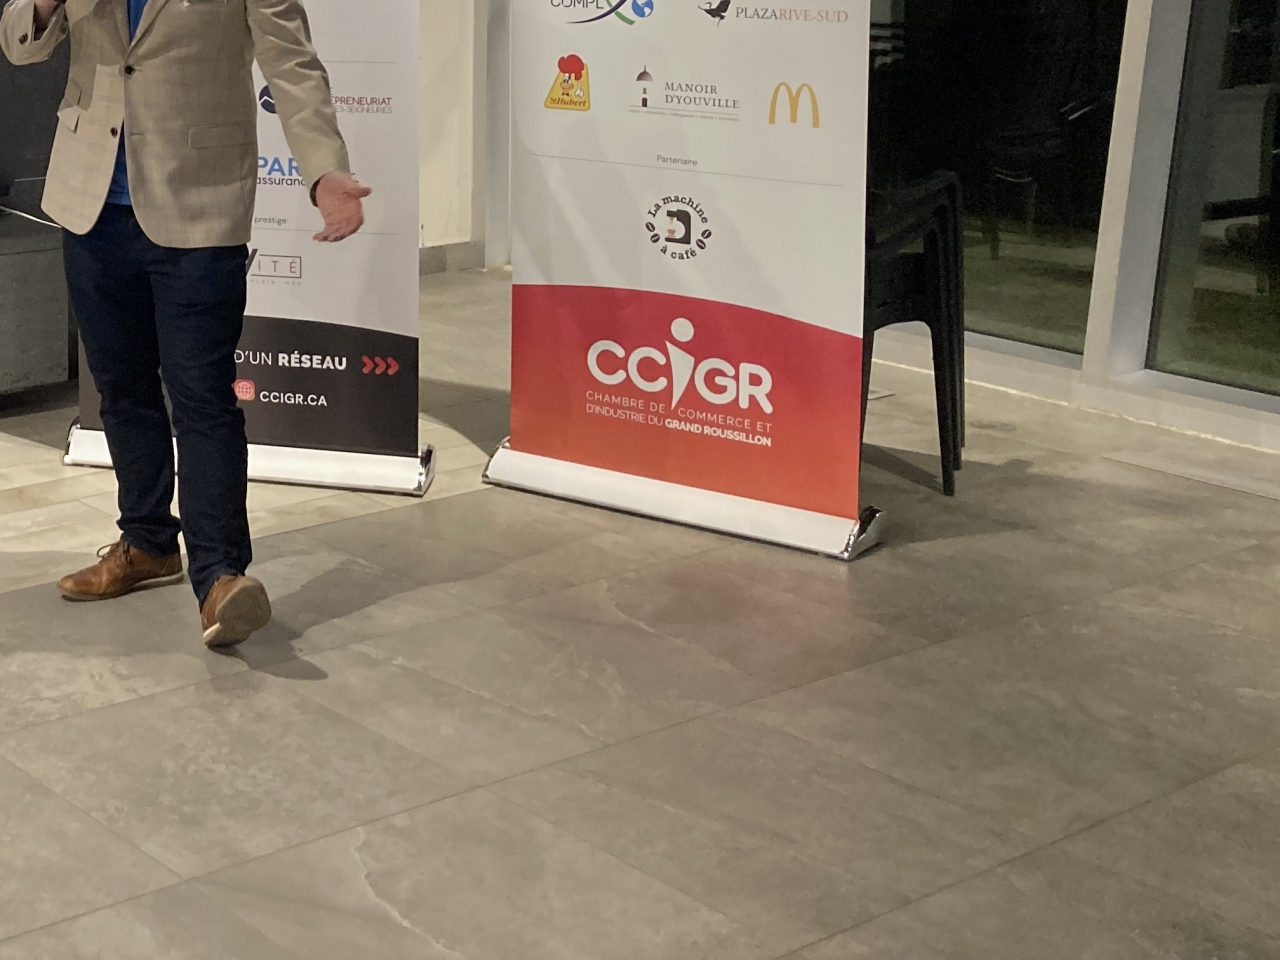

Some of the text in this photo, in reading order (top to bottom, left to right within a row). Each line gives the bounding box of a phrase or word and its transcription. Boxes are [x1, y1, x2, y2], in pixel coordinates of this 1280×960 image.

[664, 82, 718, 94] MANOIR
[331, 96, 392, 106] EPRENEURIAT
[665, 94, 740, 109] D'YOUVILLE
[656, 154, 698, 166] Partenaire
[648, 195, 708, 224] La machine
[254, 216, 286, 226] prestige
[670, 247, 697, 260] café
[234, 350, 347, 370] D'UN RÉSEAU
[587, 317, 773, 414] CCIGR
[260, 391, 328, 406] CCIGR.CA
[586, 390, 772, 433] CHAMBRE DE COMMERCE ET
[586, 404, 772, 447] D'INDUSTRIE DU GRAND ROUSSILLON
